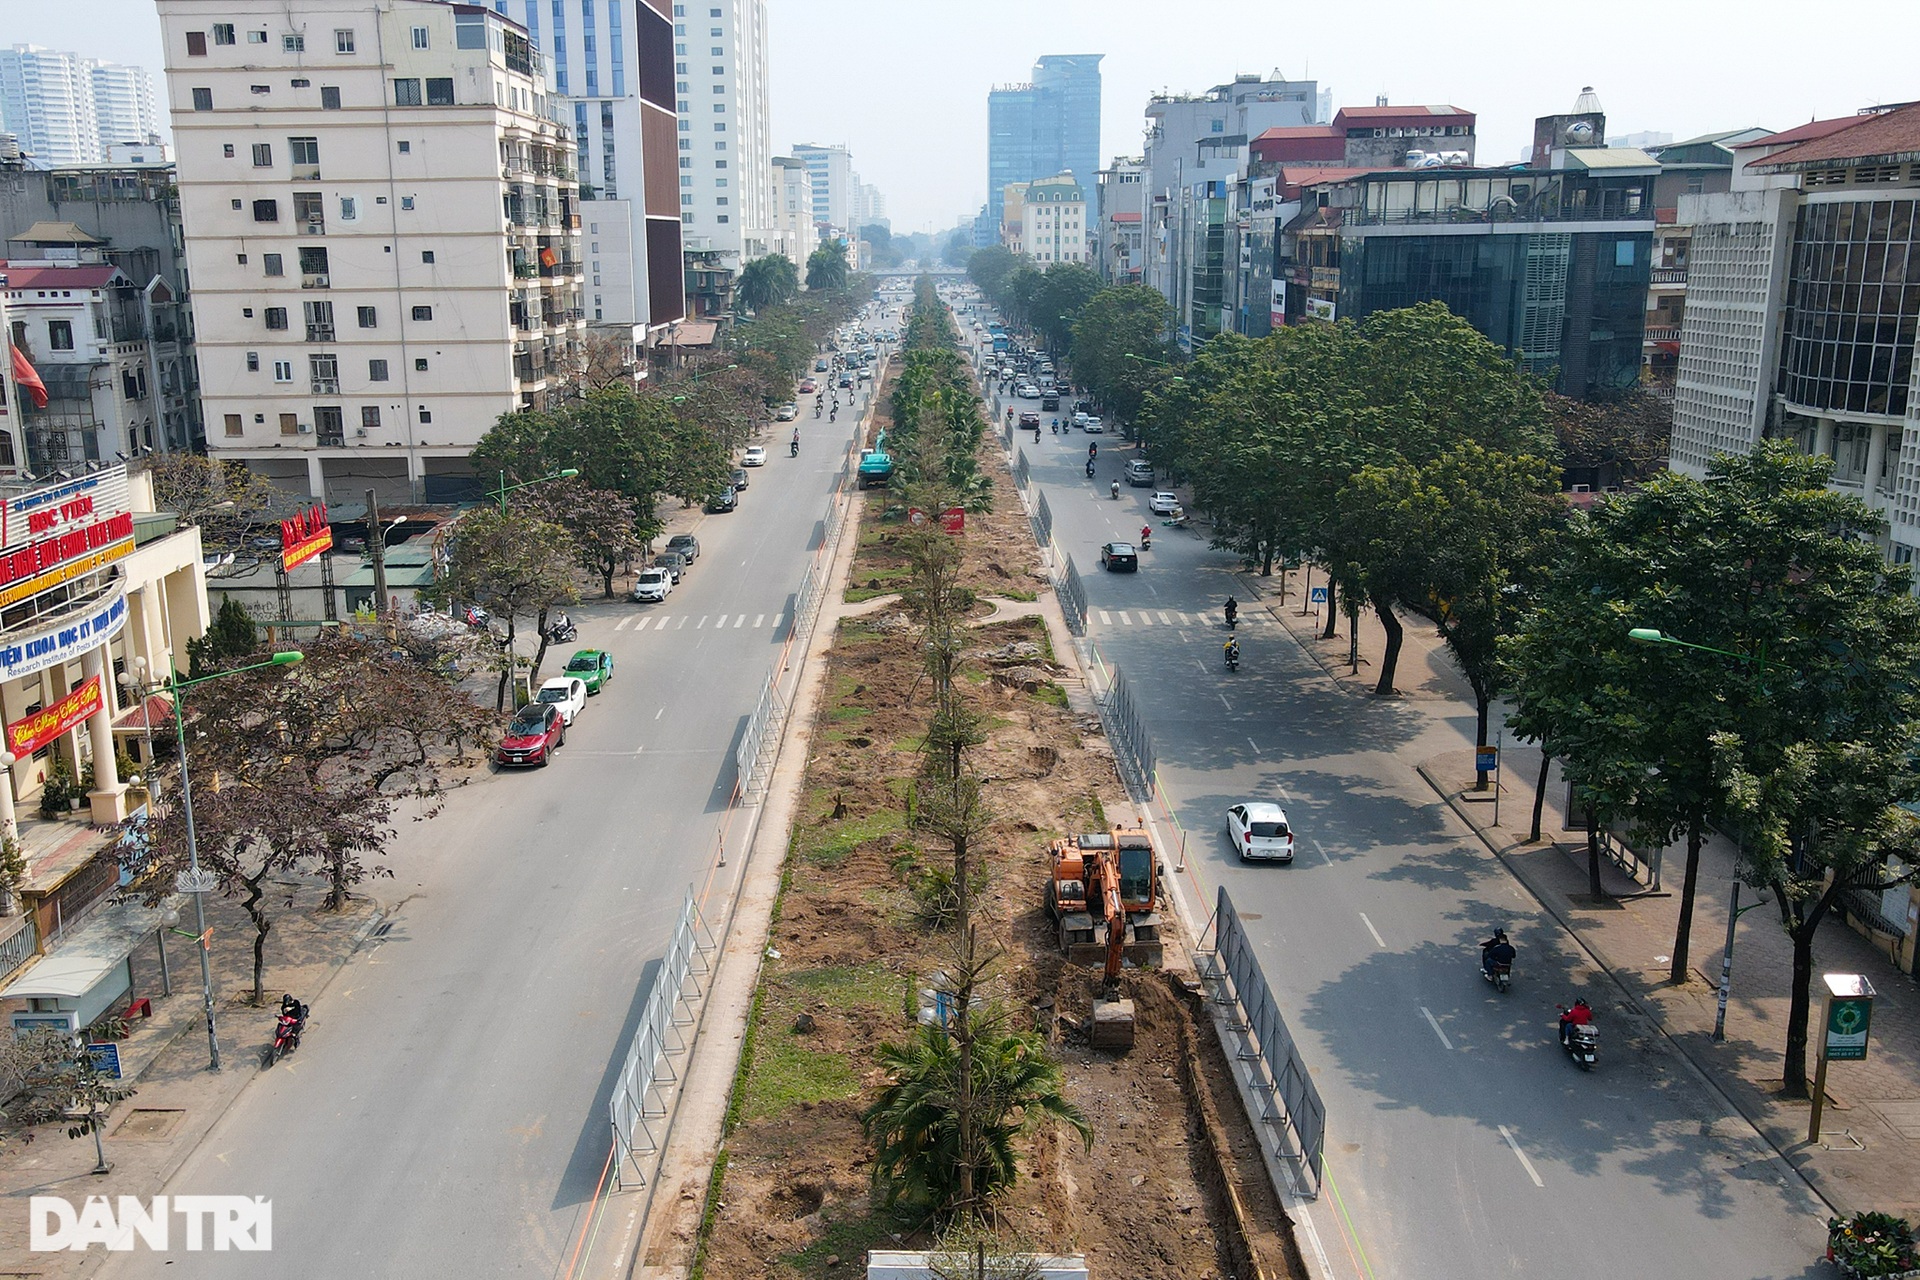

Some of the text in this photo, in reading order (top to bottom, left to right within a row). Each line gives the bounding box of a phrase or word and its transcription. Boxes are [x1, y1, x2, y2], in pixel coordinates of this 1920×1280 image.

[29, 492, 94, 536] HỌC VIỆN
[7, 661, 41, 678] Research
[42, 649, 67, 667] Institute
[69, 647, 76, 659] of
[77, 641, 91, 655] Posts
[26, 635, 56, 660] KHOA
[58, 627, 78, 650] HỌC
